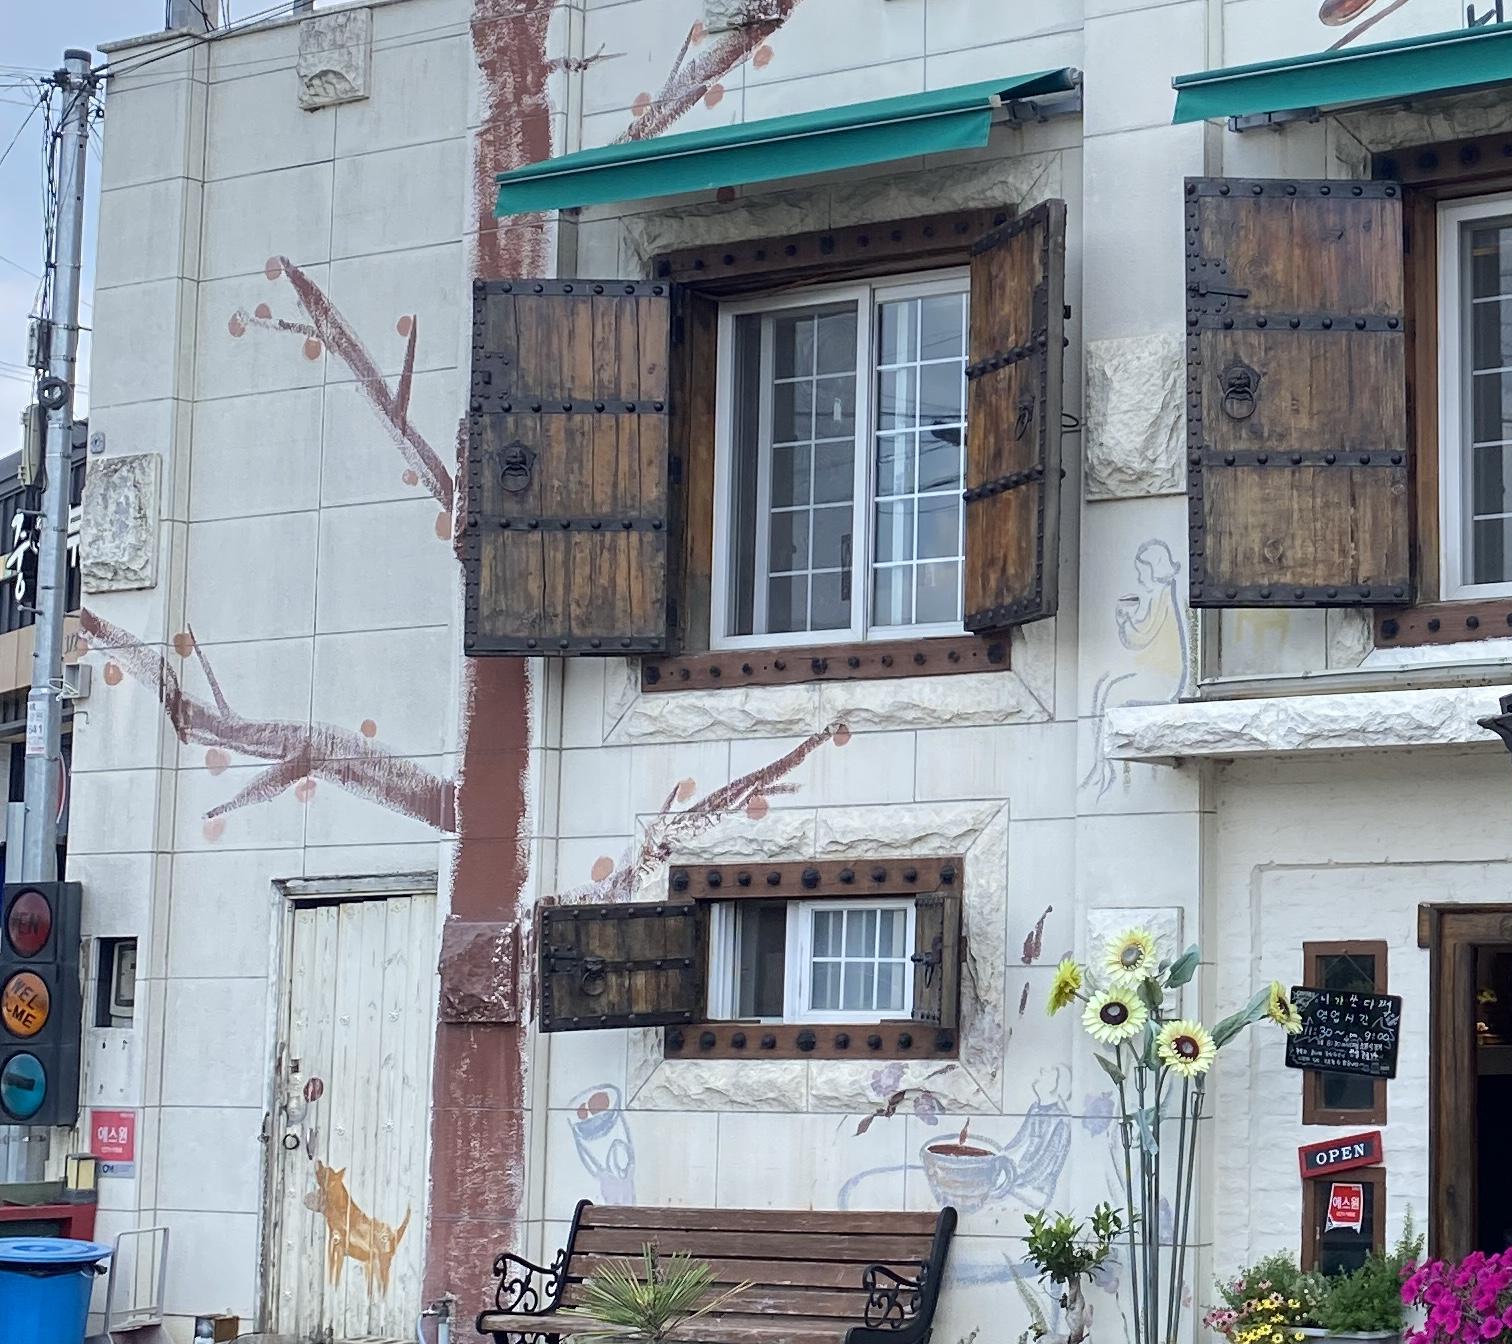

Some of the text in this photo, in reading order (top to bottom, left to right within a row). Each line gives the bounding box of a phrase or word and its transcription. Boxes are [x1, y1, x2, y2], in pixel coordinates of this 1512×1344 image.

[11, 977, 38, 1010] WEL
[97, 1126, 128, 1144] 에스원
[1315, 1143, 1365, 1165] OPEN
[1332, 1196, 1360, 1210] 에스원
